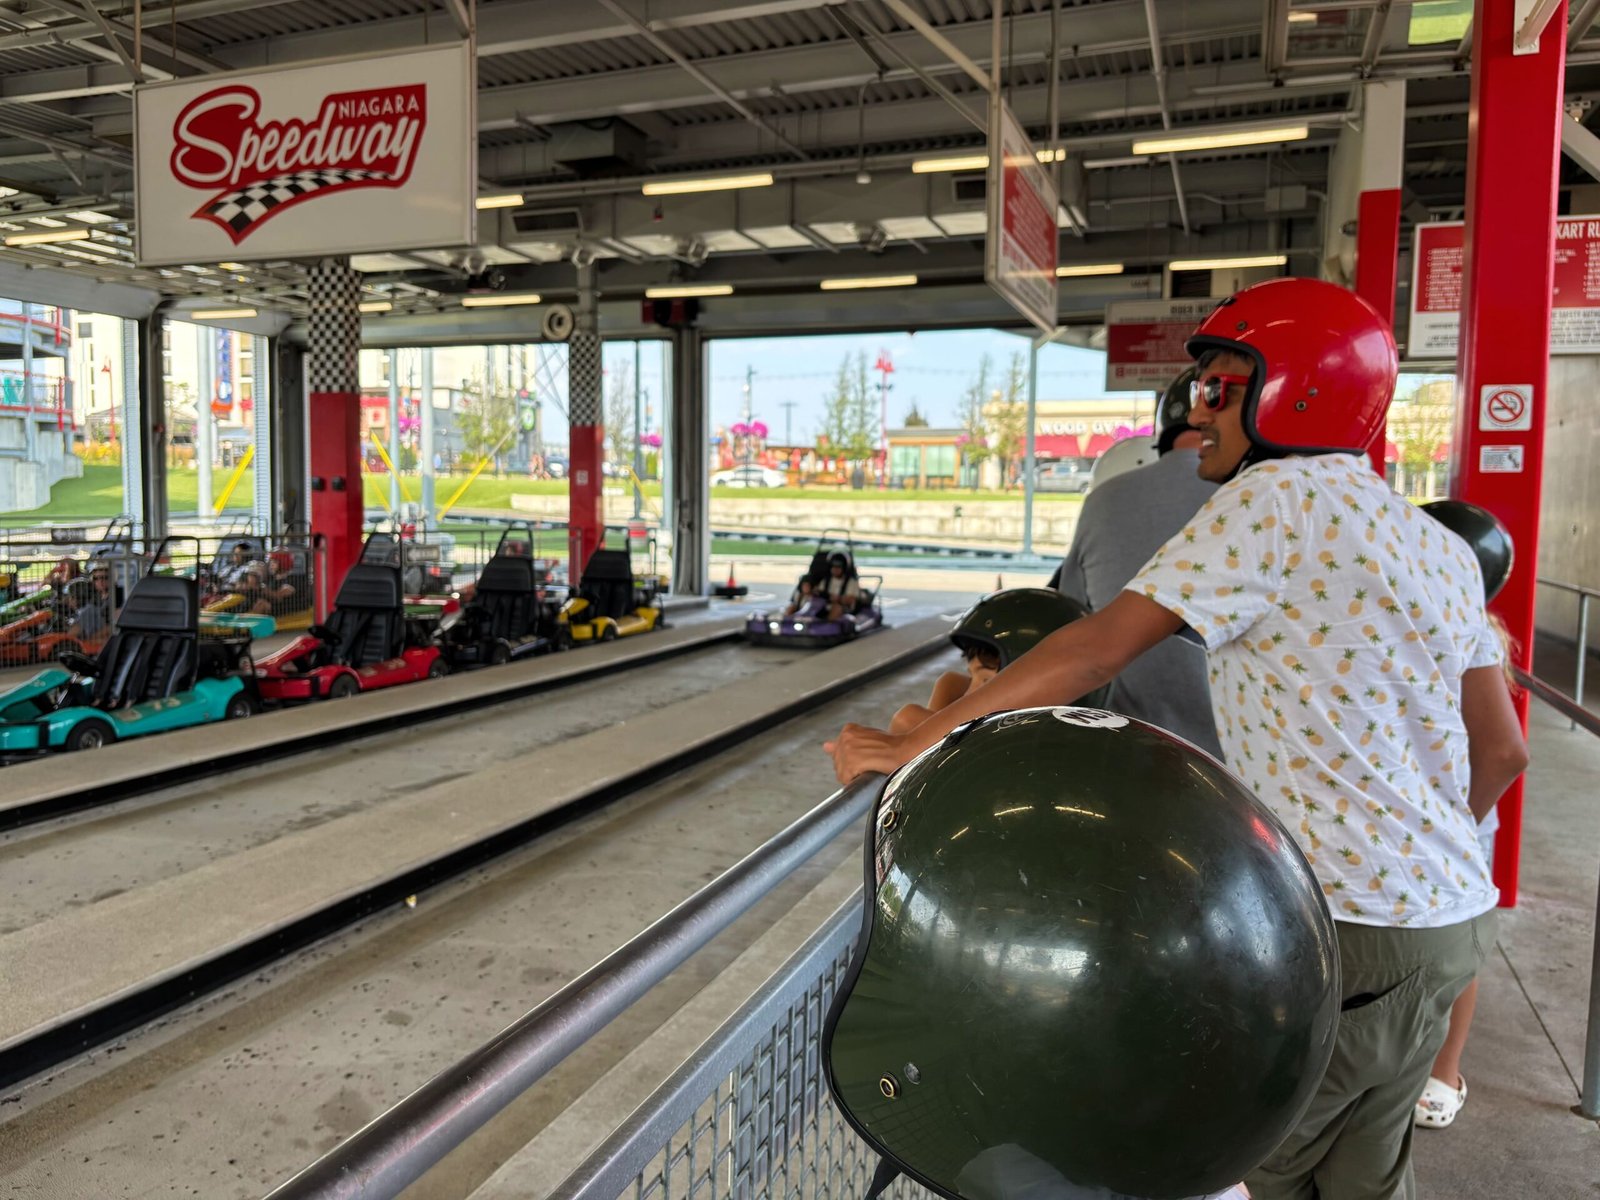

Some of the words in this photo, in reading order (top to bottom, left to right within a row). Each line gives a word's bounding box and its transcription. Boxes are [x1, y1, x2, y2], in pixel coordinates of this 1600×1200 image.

[338, 94, 419, 119] NIAGARA
[176, 92, 420, 185] Speedway
[1040, 421, 1087, 435] WOOD
